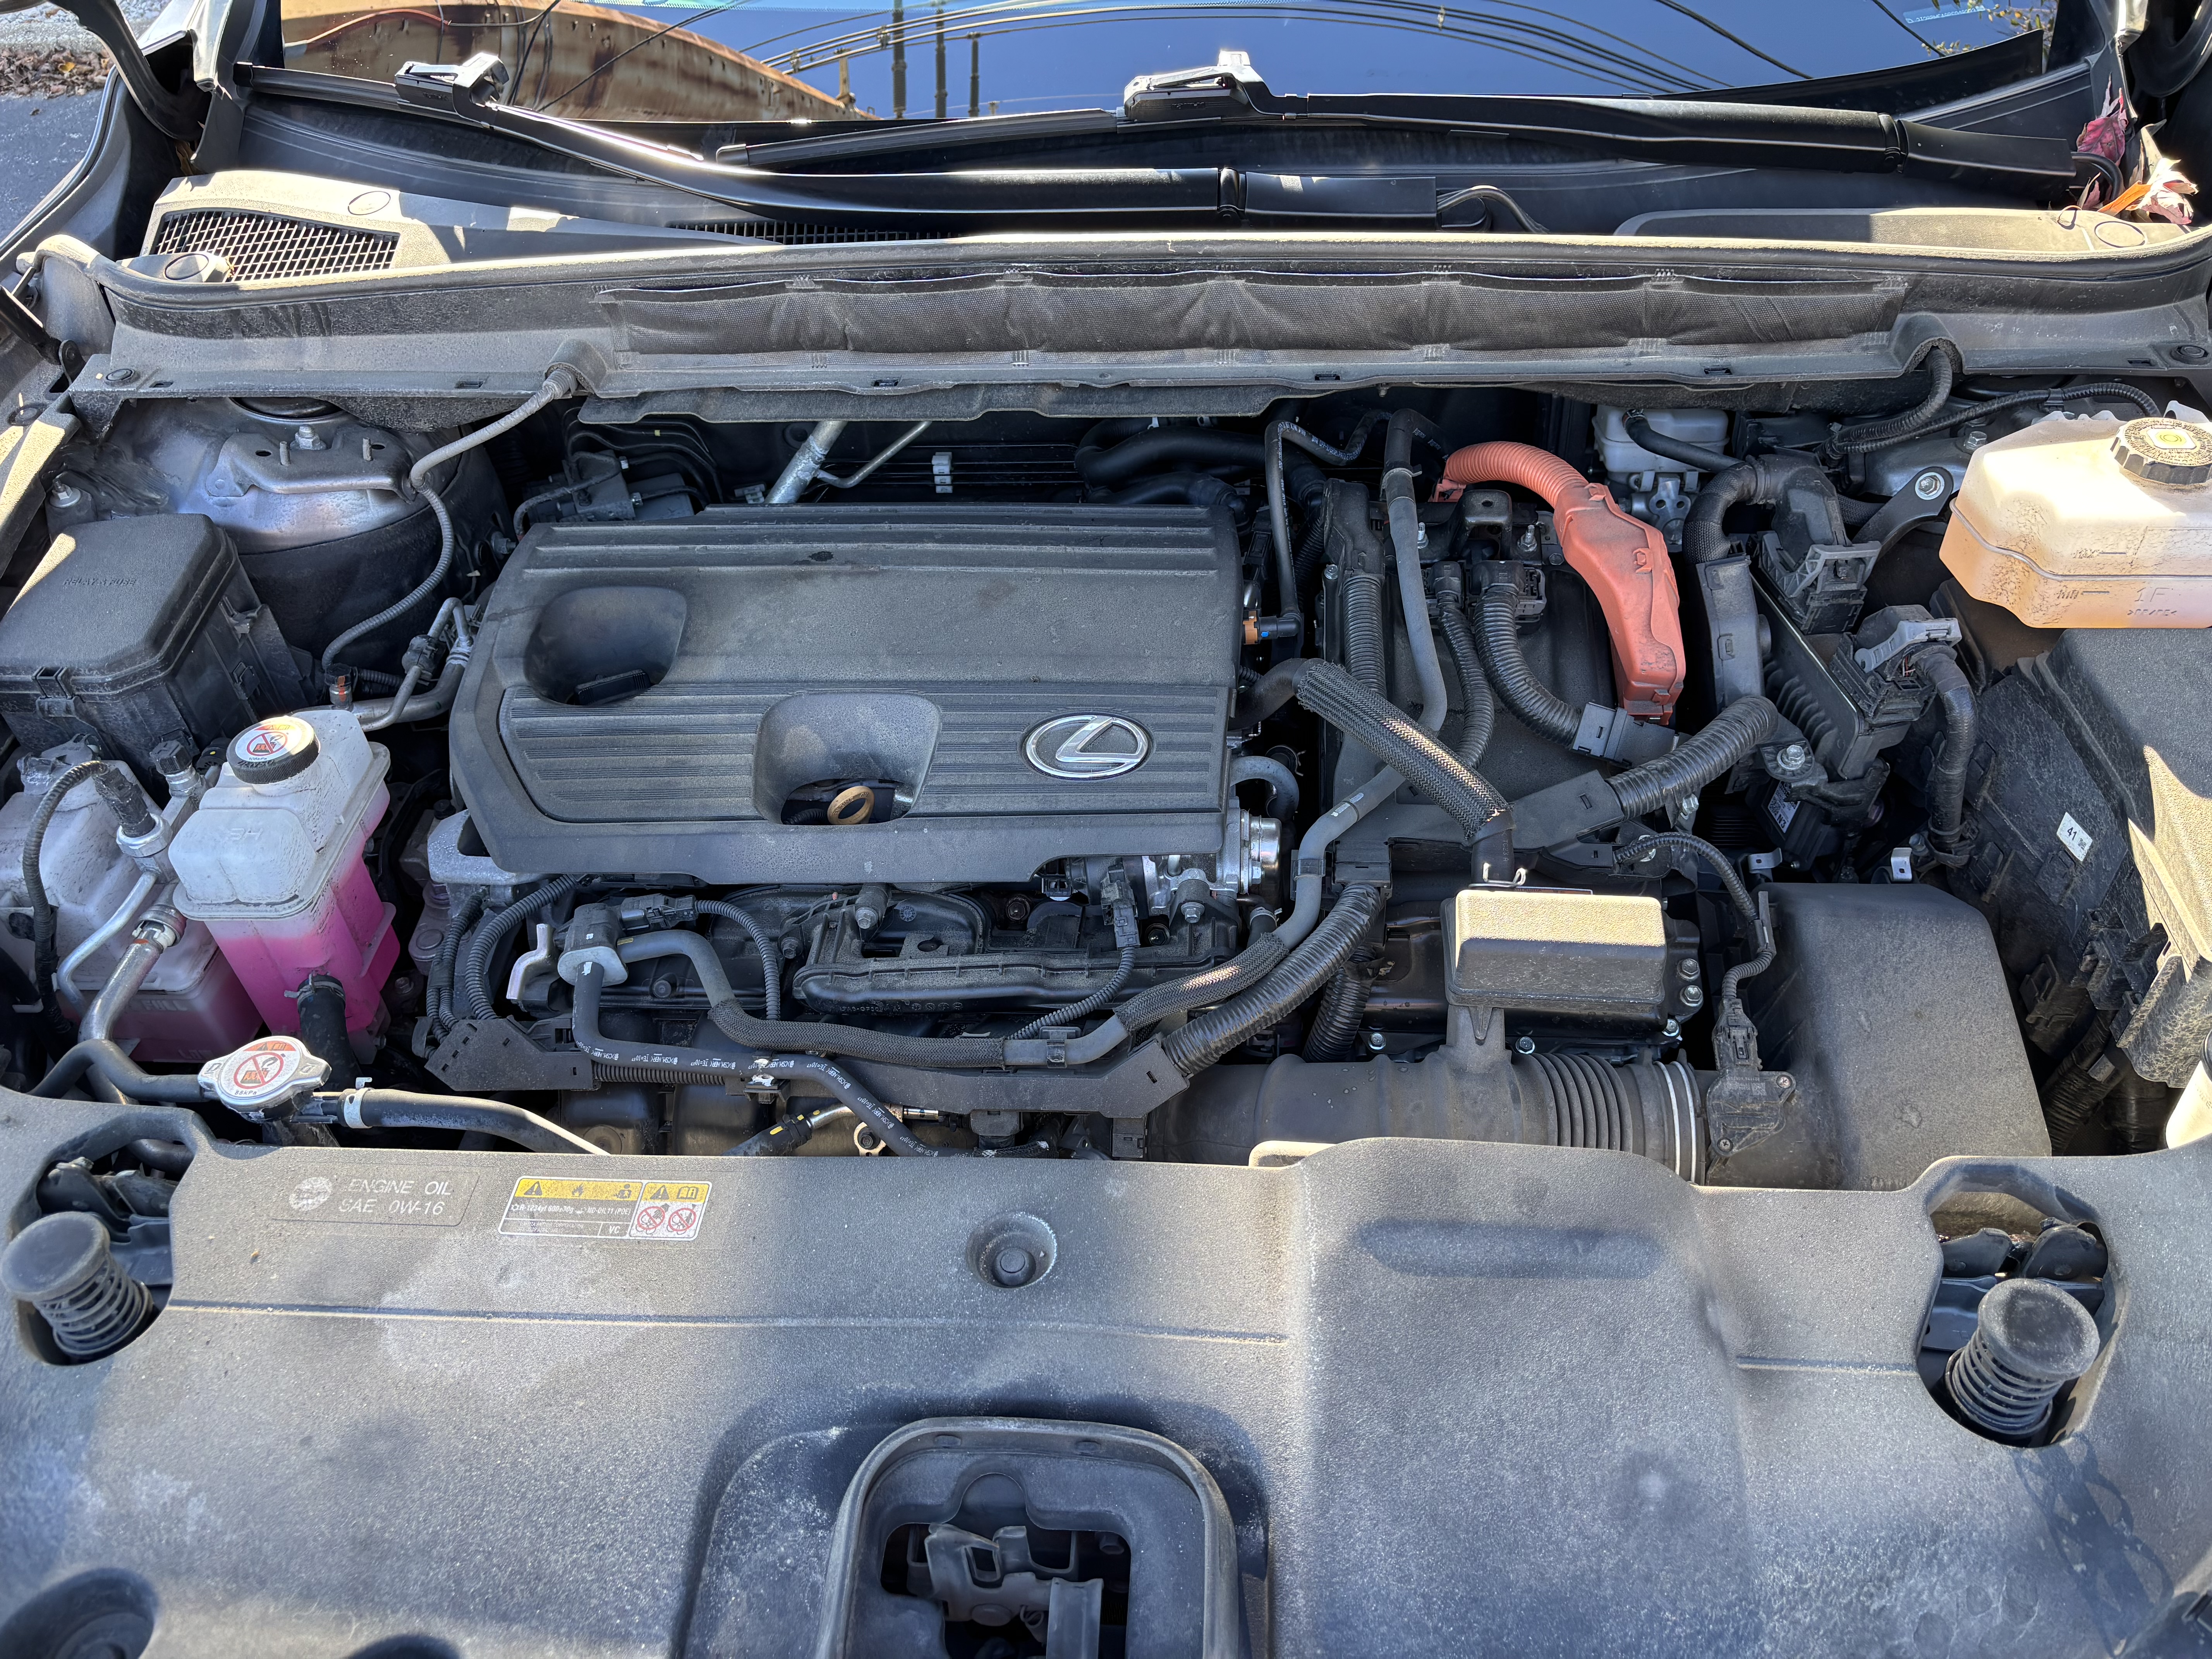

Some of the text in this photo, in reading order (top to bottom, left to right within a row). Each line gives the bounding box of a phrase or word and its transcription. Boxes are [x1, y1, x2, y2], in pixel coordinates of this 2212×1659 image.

[1777, 814, 1786, 829] N3
[2067, 826, 2077, 840] 41
[141, 1000, 188, 1011] FULL
[346, 1178, 452, 1195] ENGINE OIL
[338, 1198, 445, 1216] SAE 0W-16
[609, 1226, 620, 1234] VC
